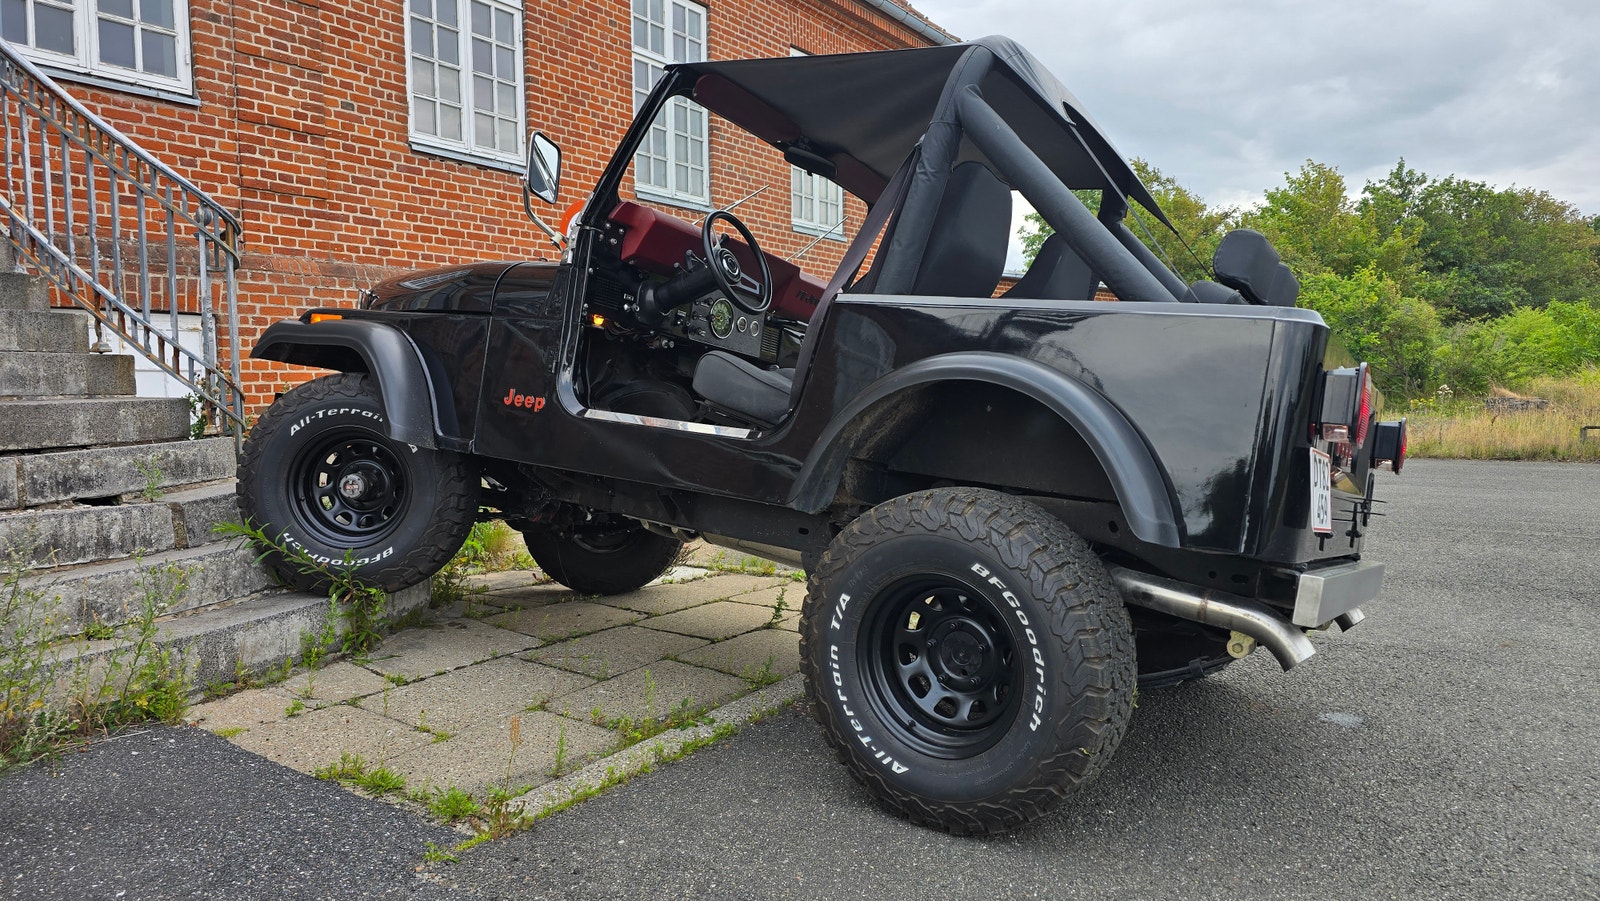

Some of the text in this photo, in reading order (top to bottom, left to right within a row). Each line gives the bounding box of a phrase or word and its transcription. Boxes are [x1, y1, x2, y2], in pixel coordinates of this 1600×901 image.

[504, 388, 546, 412] Jeep
[290, 408, 383, 437] All-Terrai
[830, 592, 851, 632] T/A
[969, 562, 1047, 733] BFGoodrich
[829, 645, 910, 776] All-Terrain
